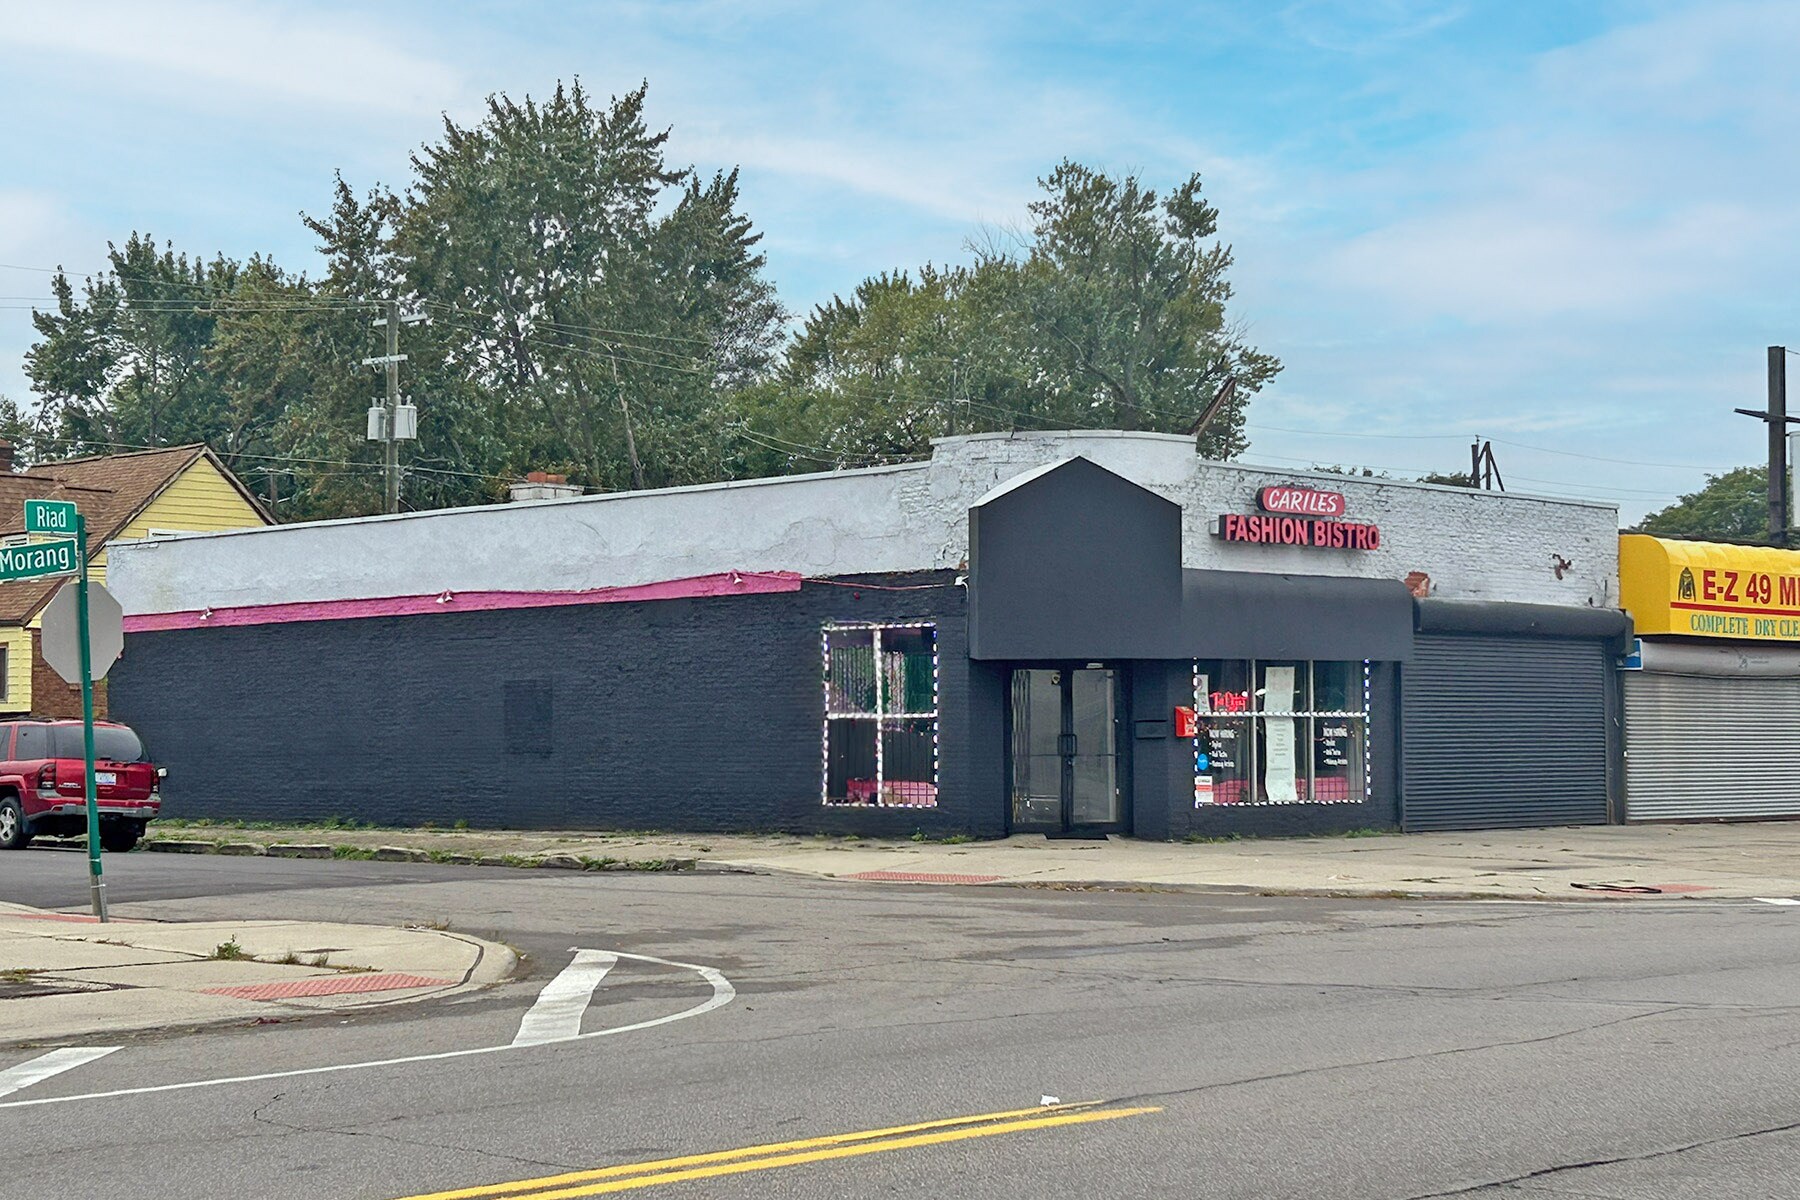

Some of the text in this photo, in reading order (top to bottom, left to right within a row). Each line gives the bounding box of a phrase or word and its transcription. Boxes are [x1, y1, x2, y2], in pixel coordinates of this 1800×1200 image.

[1269, 488, 1338, 513] CARILES
[37, 506, 66, 528] Riad
[1225, 514, 1380, 550] FASHION BISTRO
[0, 547, 69, 572] Morang
[1703, 570, 1738, 602] E-Z
[1746, 573, 1771, 605] 49
[1691, 614, 1748, 635] COMPLETE
[1755, 619, 1777, 636] DRY
